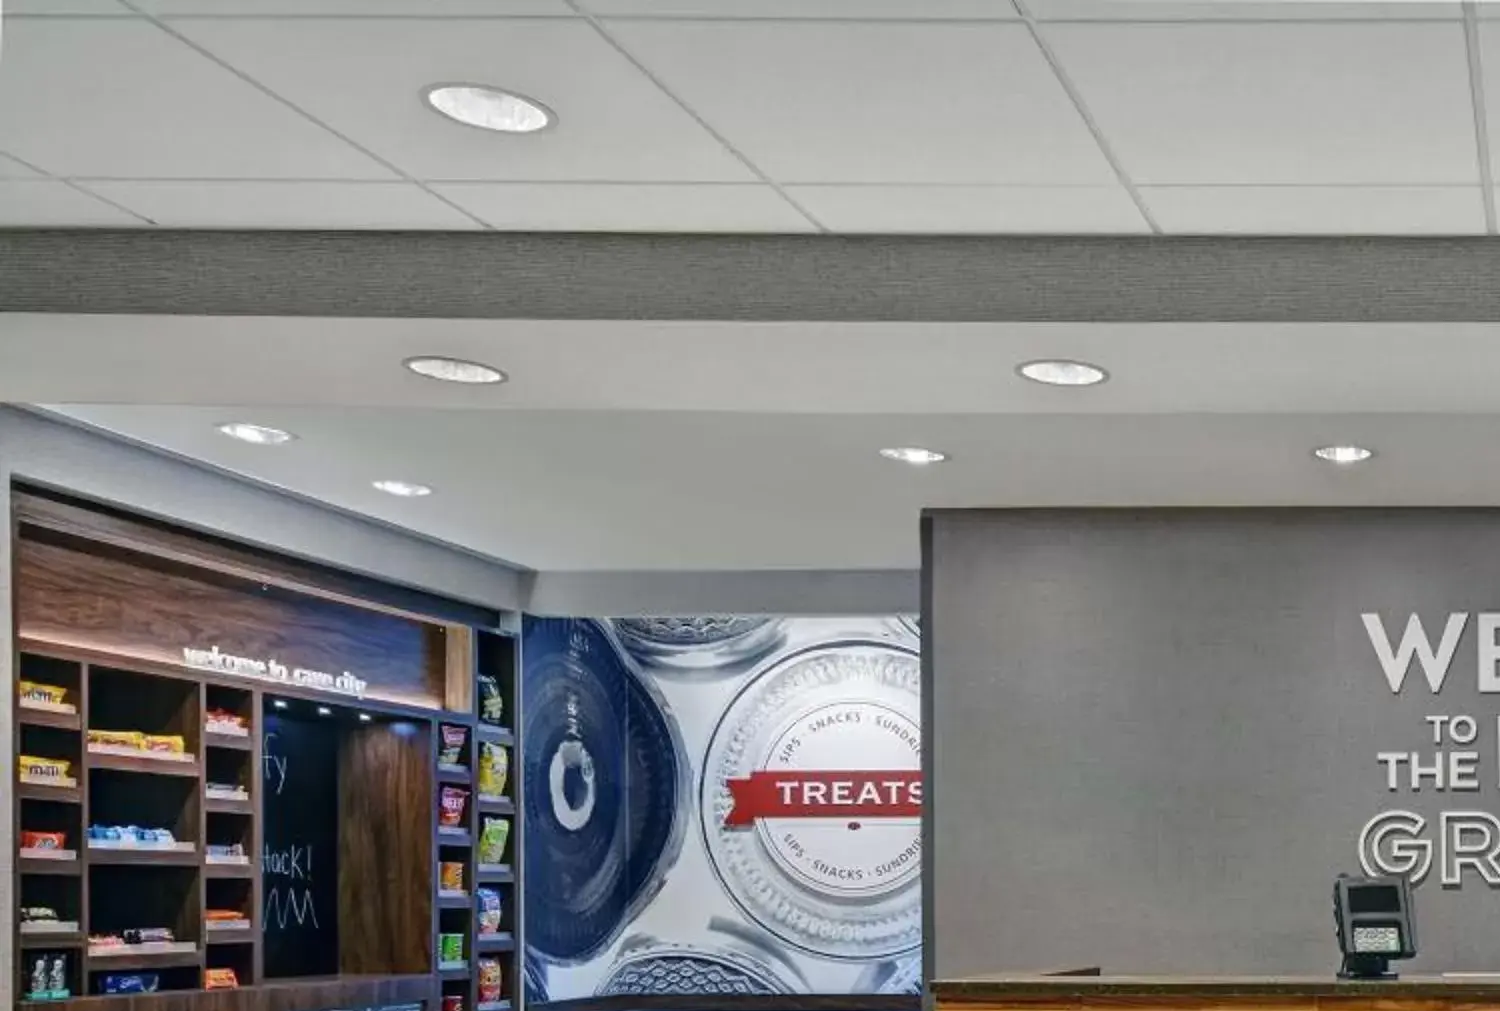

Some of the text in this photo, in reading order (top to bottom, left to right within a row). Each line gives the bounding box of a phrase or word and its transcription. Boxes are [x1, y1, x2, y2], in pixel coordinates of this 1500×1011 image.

[183, 645, 267, 676] welcome
[268, 658, 289, 680] to
[335, 671, 367, 700] city
[779, 737, 802, 764] SIPS
[808, 711, 861, 733] SNACKS
[1425, 714, 1478, 744] TO
[775, 780, 923, 806] TREATS
[1376, 751, 1480, 791] THE
[783, 832, 806, 858] SIPS
[812, 859, 864, 880] SNACKS
